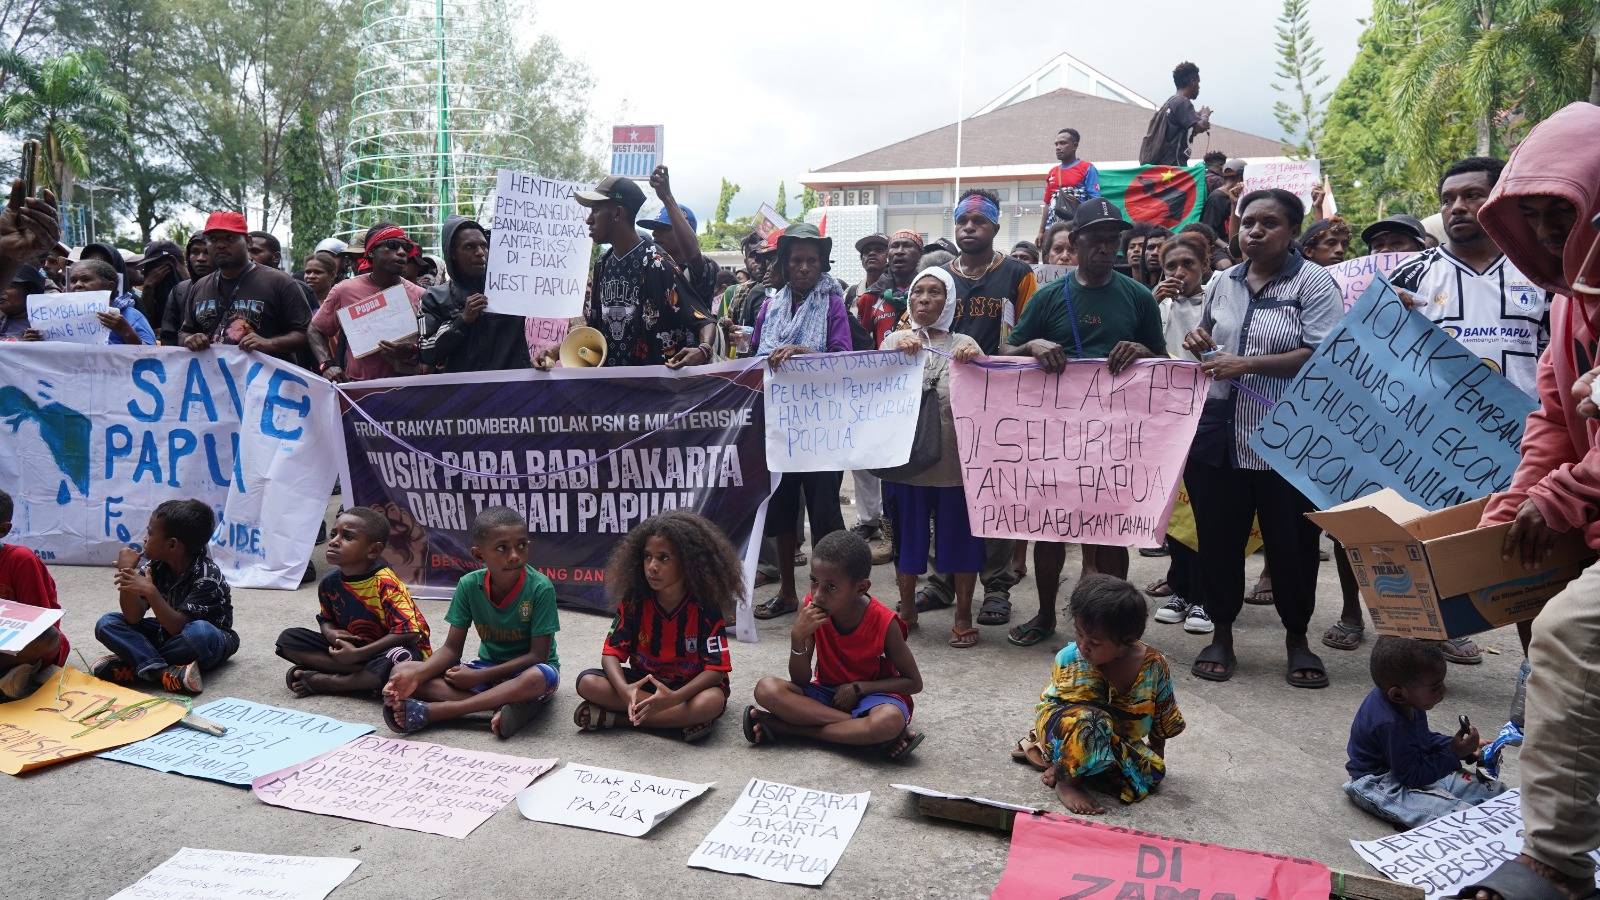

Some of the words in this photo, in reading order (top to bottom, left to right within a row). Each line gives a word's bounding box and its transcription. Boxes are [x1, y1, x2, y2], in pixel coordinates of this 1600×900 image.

[613, 144, 631, 152] WEST
[633, 144, 655, 152] PAPUA
[493, 216, 543, 235] BANDARA
[548, 223, 586, 239] UDARA
[499, 234, 577, 253] ANTARIKSA
[489, 272, 528, 292] WEST
[534, 276, 580, 297] PAPUA
[1362, 276, 1468, 389] TOLAK
[1464, 327, 1497, 337] BANK
[1322, 327, 1435, 438] KAWASAN
[127, 357, 311, 441] SAVE
[779, 402, 821, 428] HAM
[849, 397, 915, 424] SELURUH
[1292, 363, 1386, 453] KHUSUS
[354, 421, 393, 437] FRONT
[397, 419, 453, 437] RAKYAT
[457, 416, 535, 435] DOMBERAI
[538, 415, 588, 433] TOLAK
[592, 414, 625, 432] PSN
[629, 414, 640, 431] &
[645, 408, 753, 430] MILITERISME
[993, 418, 1143, 463] SELURUH
[442, 450, 520, 490] PARA
[526, 449, 599, 490] BABI
[607, 445, 744, 489] JAKARTA
[1076, 465, 1166, 503] PAPUA
[406, 492, 467, 531] DARI
[200, 702, 343, 734] HENTIKAN
[350, 736, 419, 758] TOLAK
[574, 769, 624, 786] TOLAK
[630, 779, 692, 800] SAWIT
[749, 780, 797, 804] USIR
[801, 791, 859, 811] PARA
[566, 795, 645, 823] PAPUA
[749, 800, 828, 823] BABI
[730, 814, 839, 840] JAKARTA
[751, 831, 801, 849] DARI
[702, 840, 763, 863] TANAH
[763, 850, 828, 875] PAPUA
[1136, 843, 1183, 882] DI
[1380, 829, 1487, 879] RENCANA
[1411, 840, 1521, 896] SEBESAR
